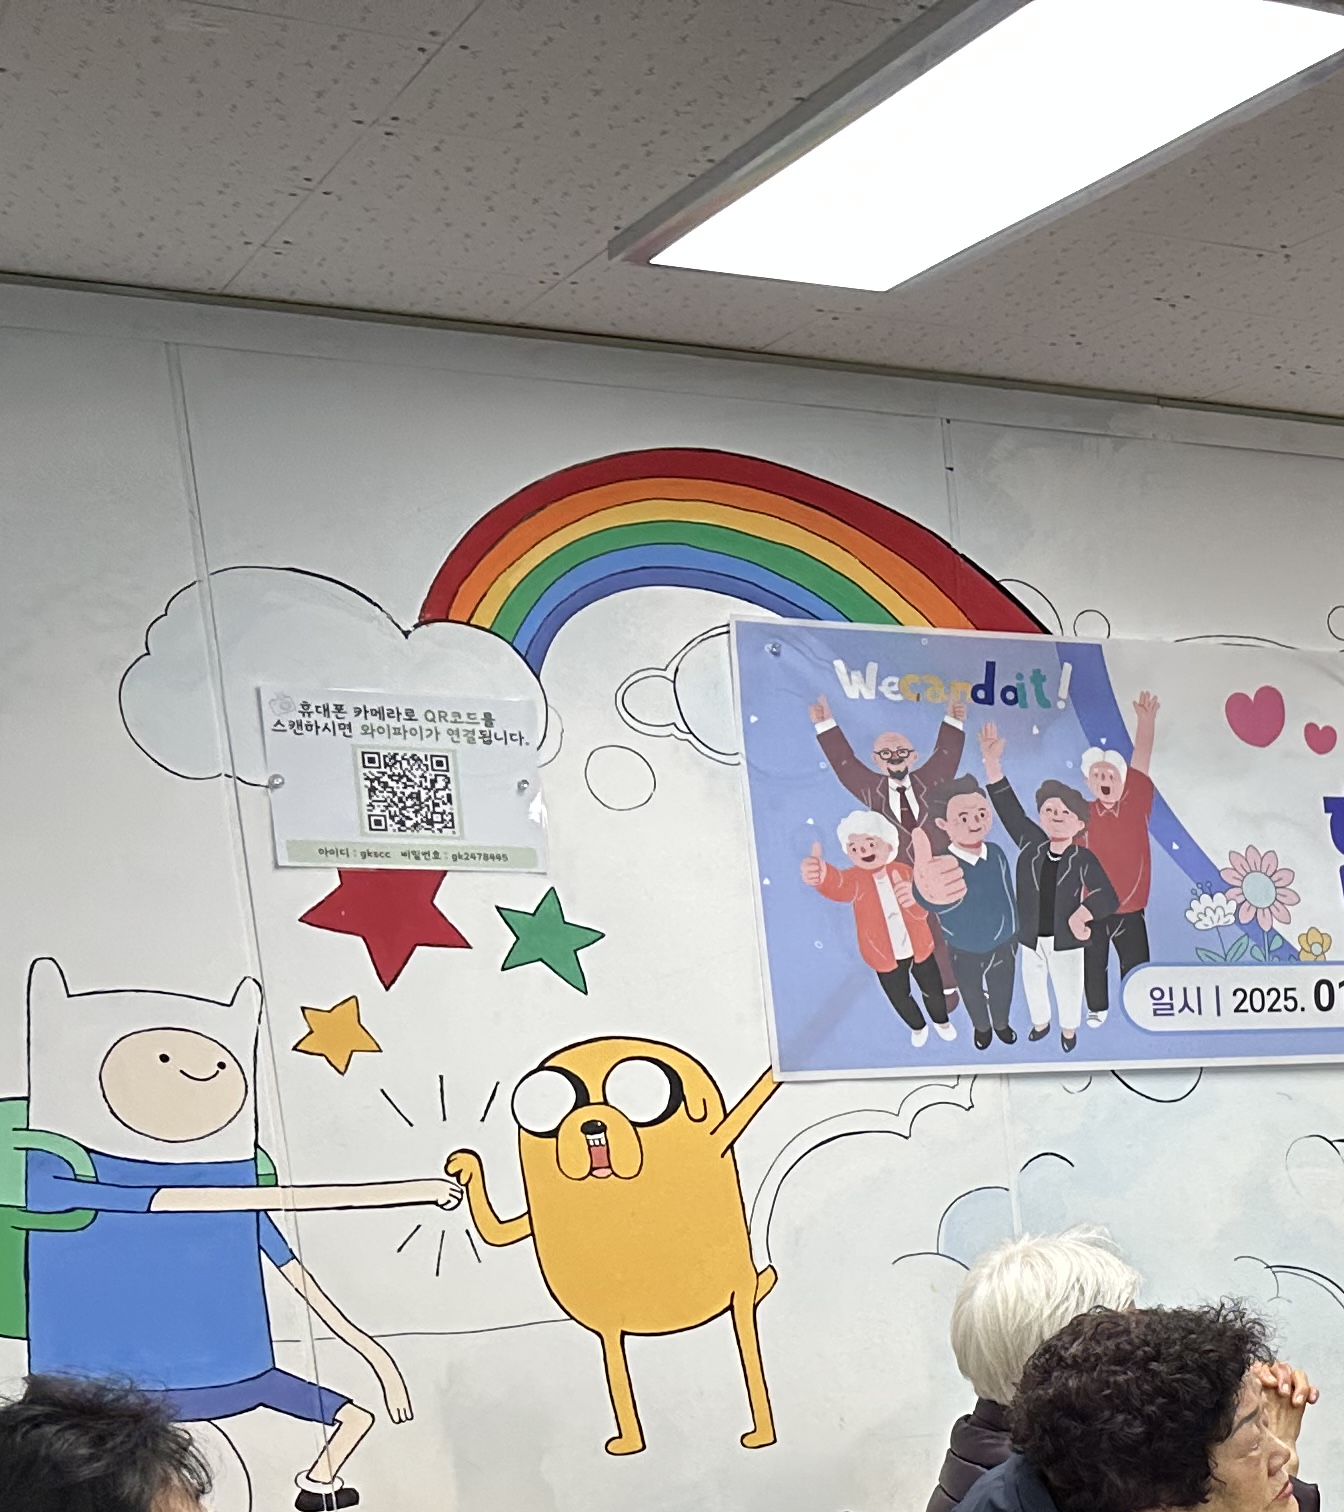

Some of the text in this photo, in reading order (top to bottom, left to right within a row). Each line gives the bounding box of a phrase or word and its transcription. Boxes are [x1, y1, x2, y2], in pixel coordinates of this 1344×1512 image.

[298, 700, 496, 728] 휴대폰 카메라로 QR코드를
[271, 719, 530, 746] 스캔하시면 와이파이가 연결됩니다.
[318, 847, 350, 859] 아이디
[1149, 986, 1202, 1017] 일시
[1232, 986, 1305, 1014] 2025.
